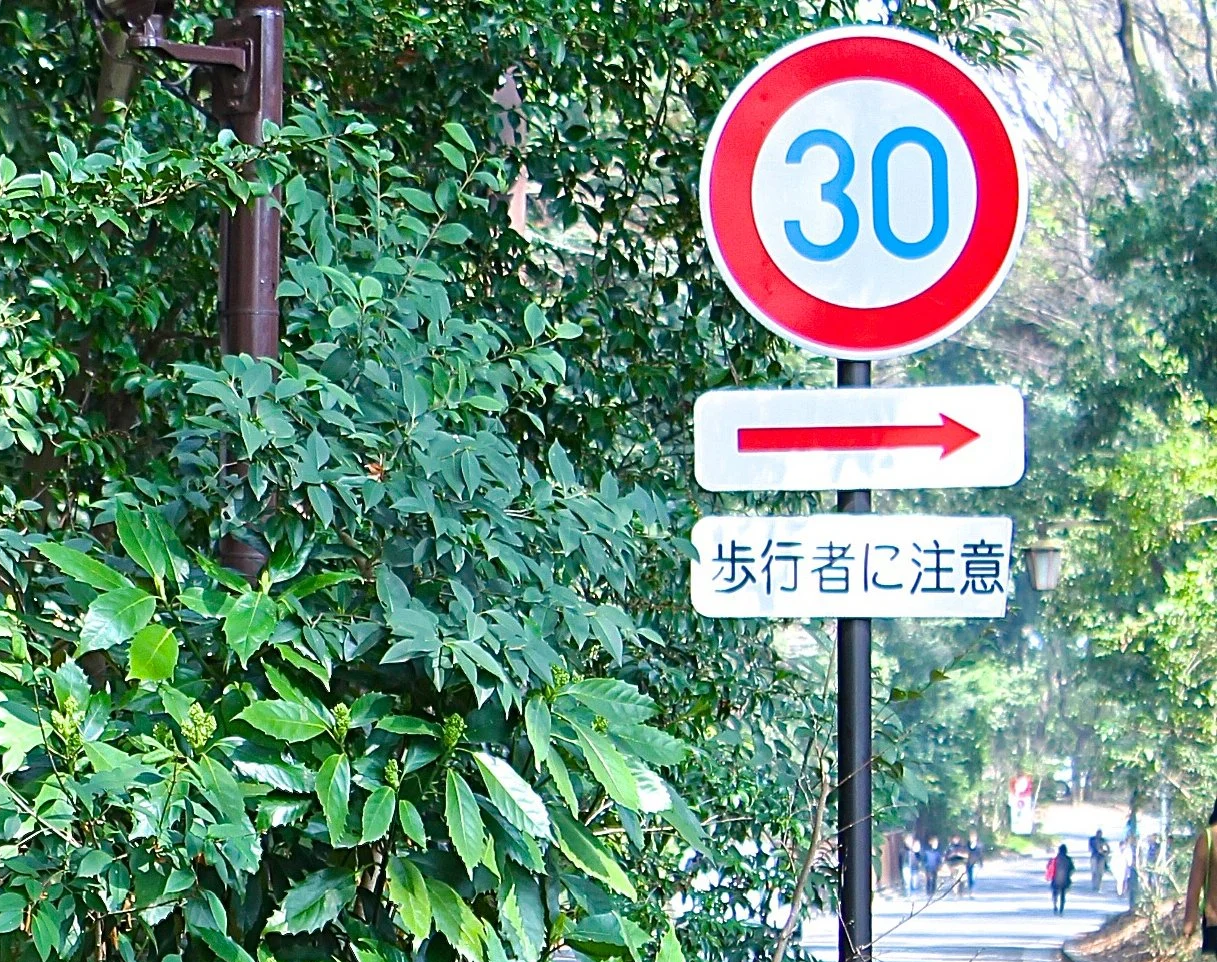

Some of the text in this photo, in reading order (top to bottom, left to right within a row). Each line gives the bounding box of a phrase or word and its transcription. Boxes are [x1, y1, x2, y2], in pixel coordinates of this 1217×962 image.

[784, 126, 950, 262] 30
[712, 539, 1006, 595] 歩行者に注意
